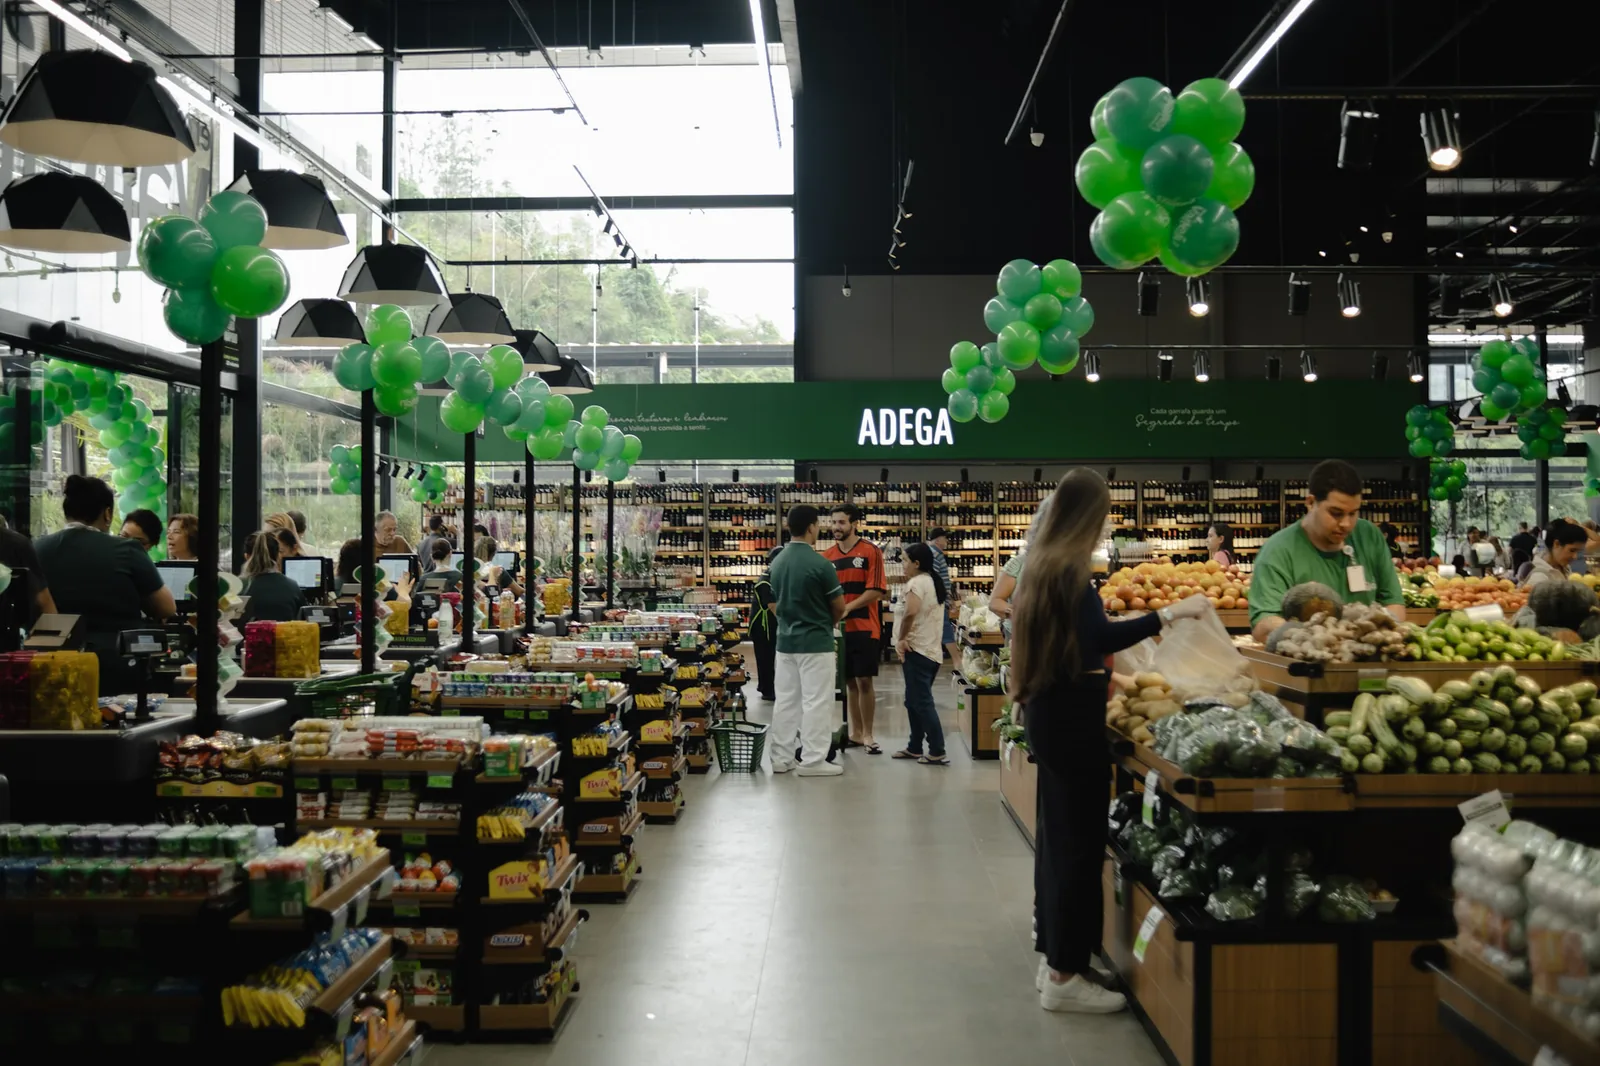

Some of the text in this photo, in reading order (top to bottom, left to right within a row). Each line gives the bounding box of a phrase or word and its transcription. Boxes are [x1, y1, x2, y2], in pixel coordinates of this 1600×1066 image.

[858, 408, 954, 446] ADEGA
[1135, 414, 1184, 431] Segredo
[1205, 415, 1240, 431] tempo
[629, 425, 649, 433] Valleju
[646, 726, 664, 735] Twix
[585, 779, 610, 789] Twix
[496, 871, 529, 887] Twix
[492, 934, 523, 945] SNICKERS
